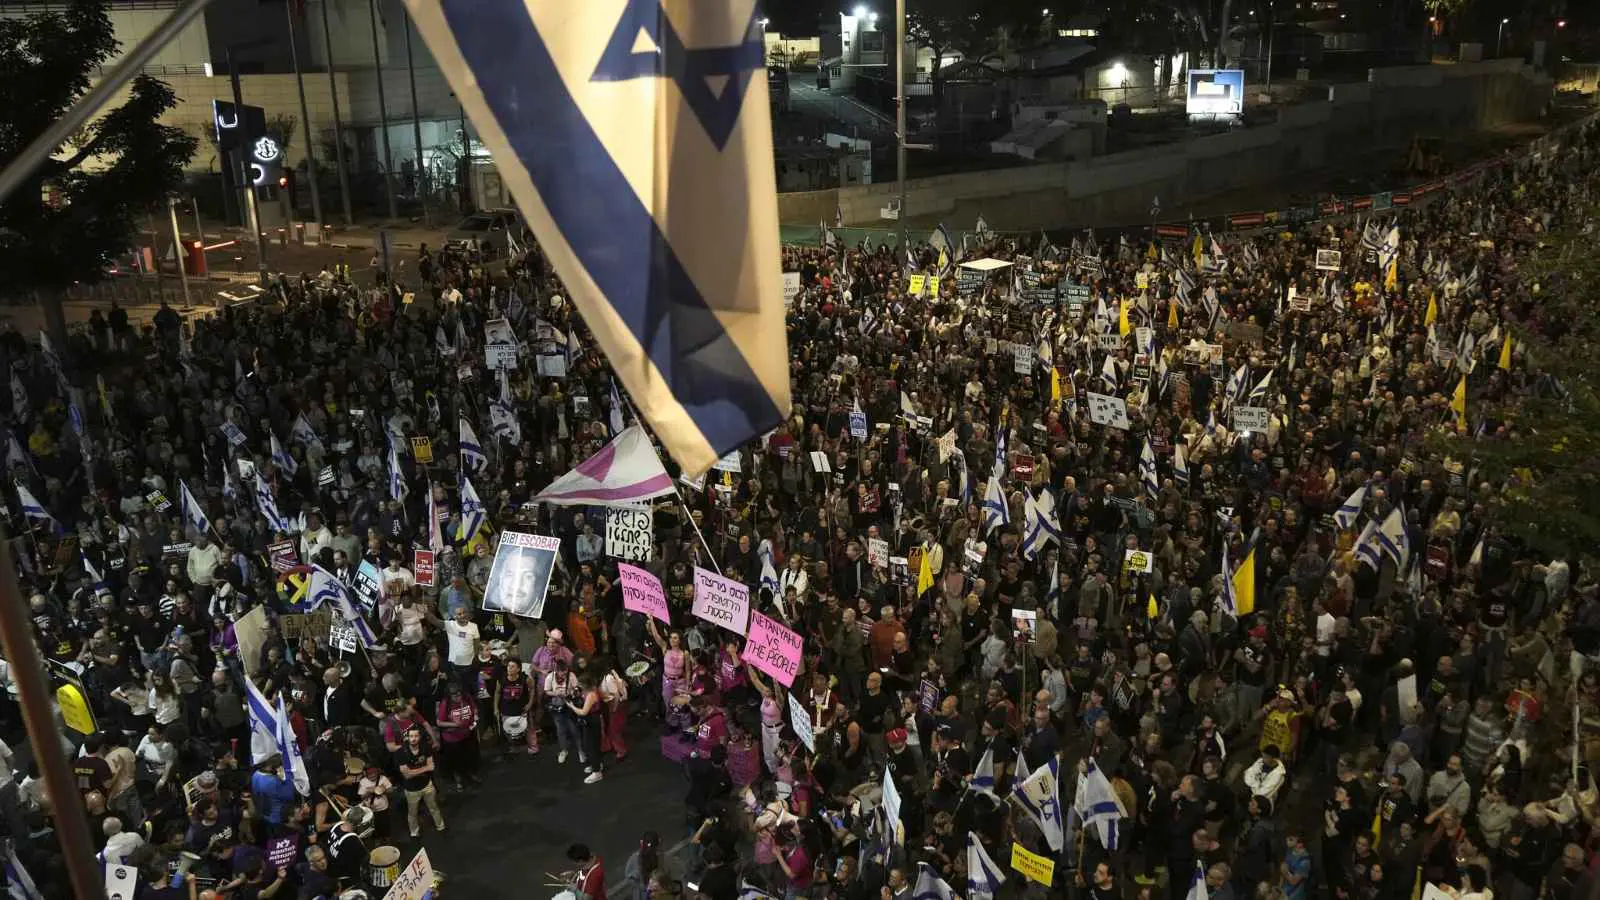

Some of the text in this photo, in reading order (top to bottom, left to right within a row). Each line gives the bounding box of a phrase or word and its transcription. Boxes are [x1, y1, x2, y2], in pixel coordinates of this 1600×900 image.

[607, 507, 650, 530] פושעים
[502, 532, 559, 550] BIBI ESCOBAR
[612, 541, 650, 562] עלינו
[752, 609, 800, 649] NETANYAHU
[748, 640, 797, 676] THE PEOPLE
